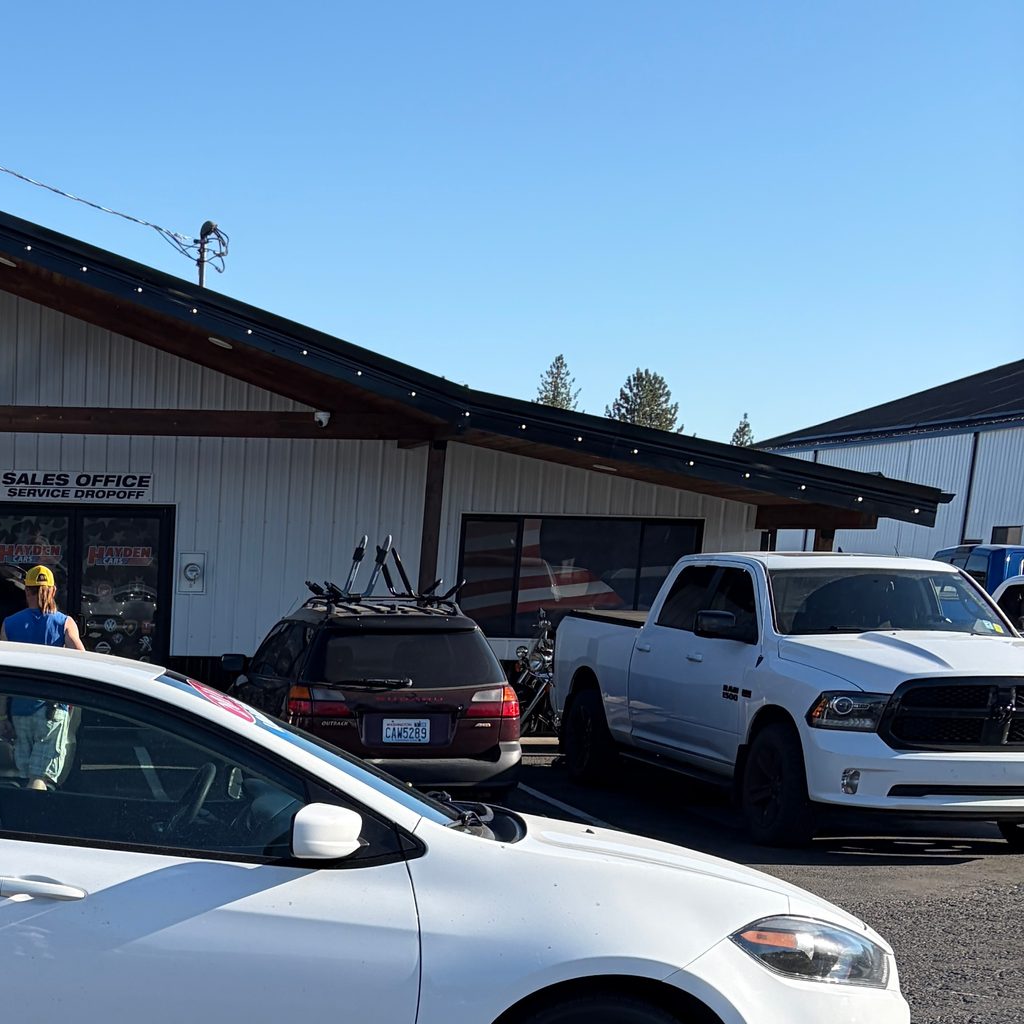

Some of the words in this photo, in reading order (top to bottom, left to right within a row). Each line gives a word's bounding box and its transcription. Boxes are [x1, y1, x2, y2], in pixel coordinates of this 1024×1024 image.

[1, 472, 69, 486] SALES
[75, 474, 152, 488] OFFICE
[7, 487, 70, 498] SERVICE
[74, 489, 145, 500] DROPOFF
[87, 546, 152, 565] HAYDEN
[385, 727, 427, 739] CAW5289
